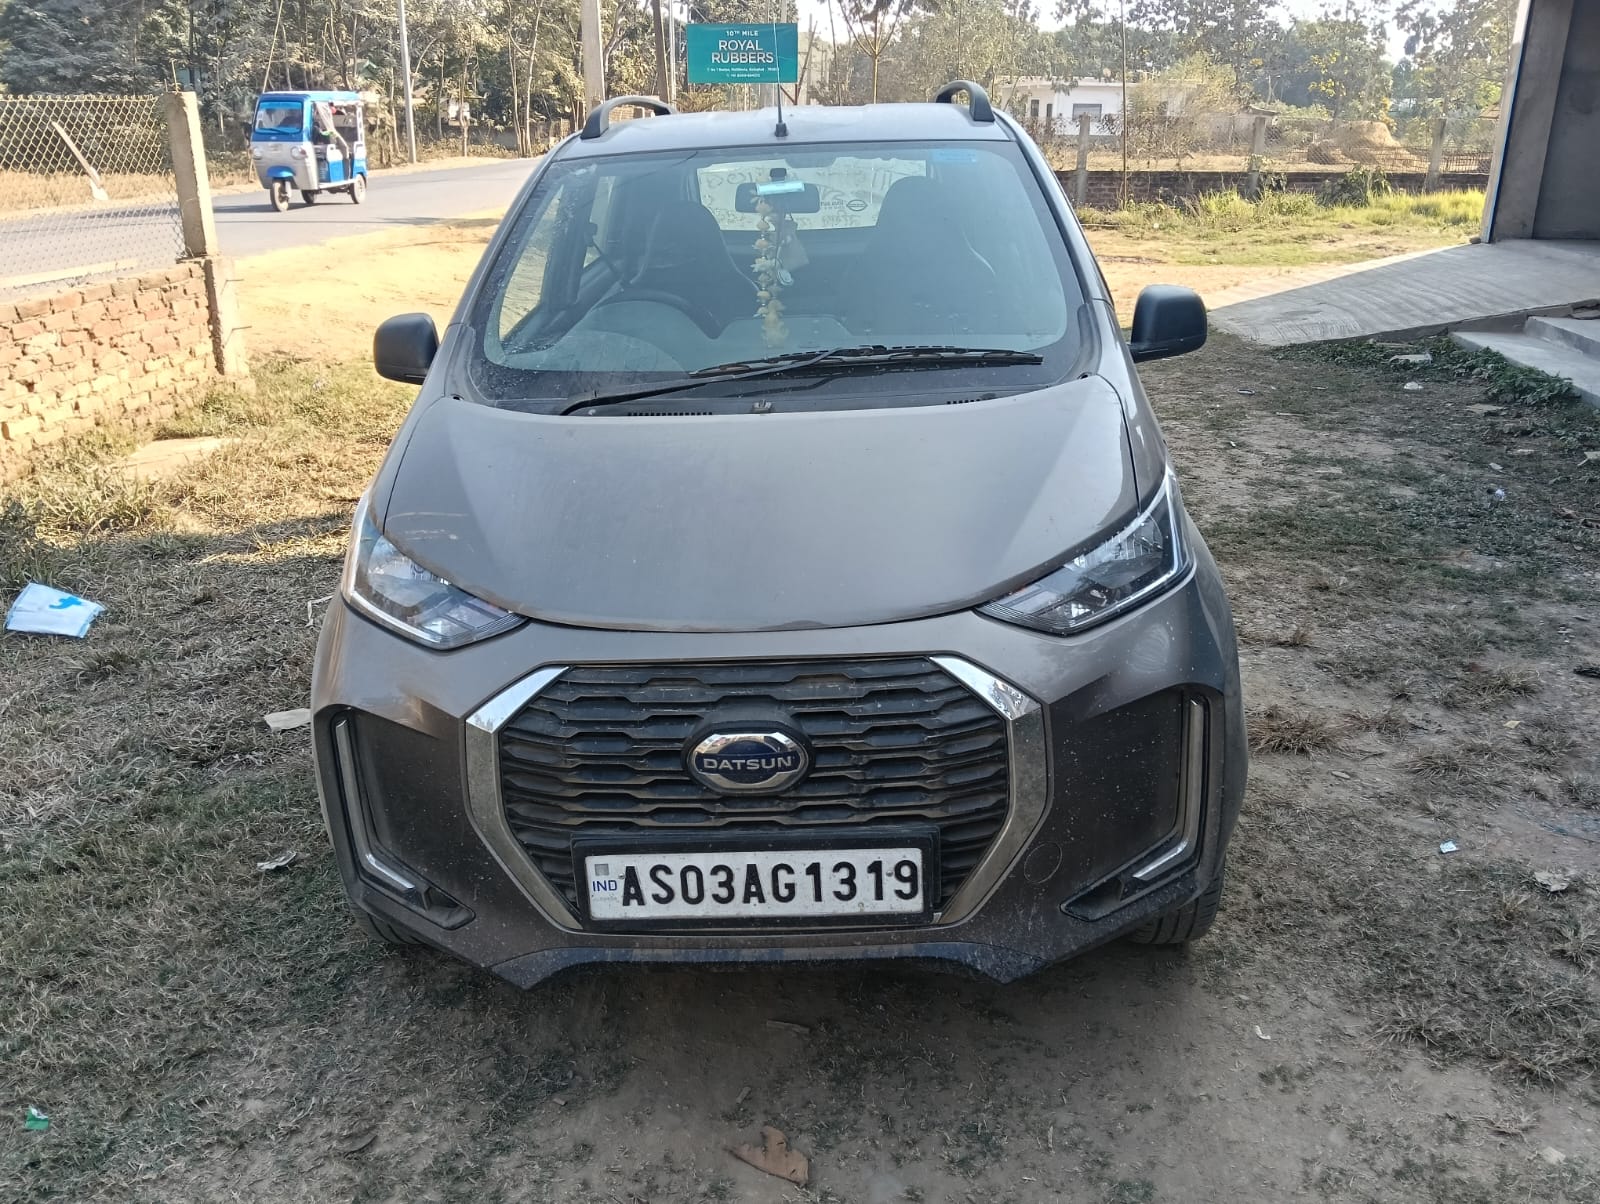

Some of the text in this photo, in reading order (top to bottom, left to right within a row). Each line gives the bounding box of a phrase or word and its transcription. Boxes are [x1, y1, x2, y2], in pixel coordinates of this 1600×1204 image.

[718, 39, 764, 51] ROYAL
[711, 52, 774, 64] RUBBERS
[703, 755, 792, 770] DATSUN
[592, 859, 919, 907] IND AS03AG1319
